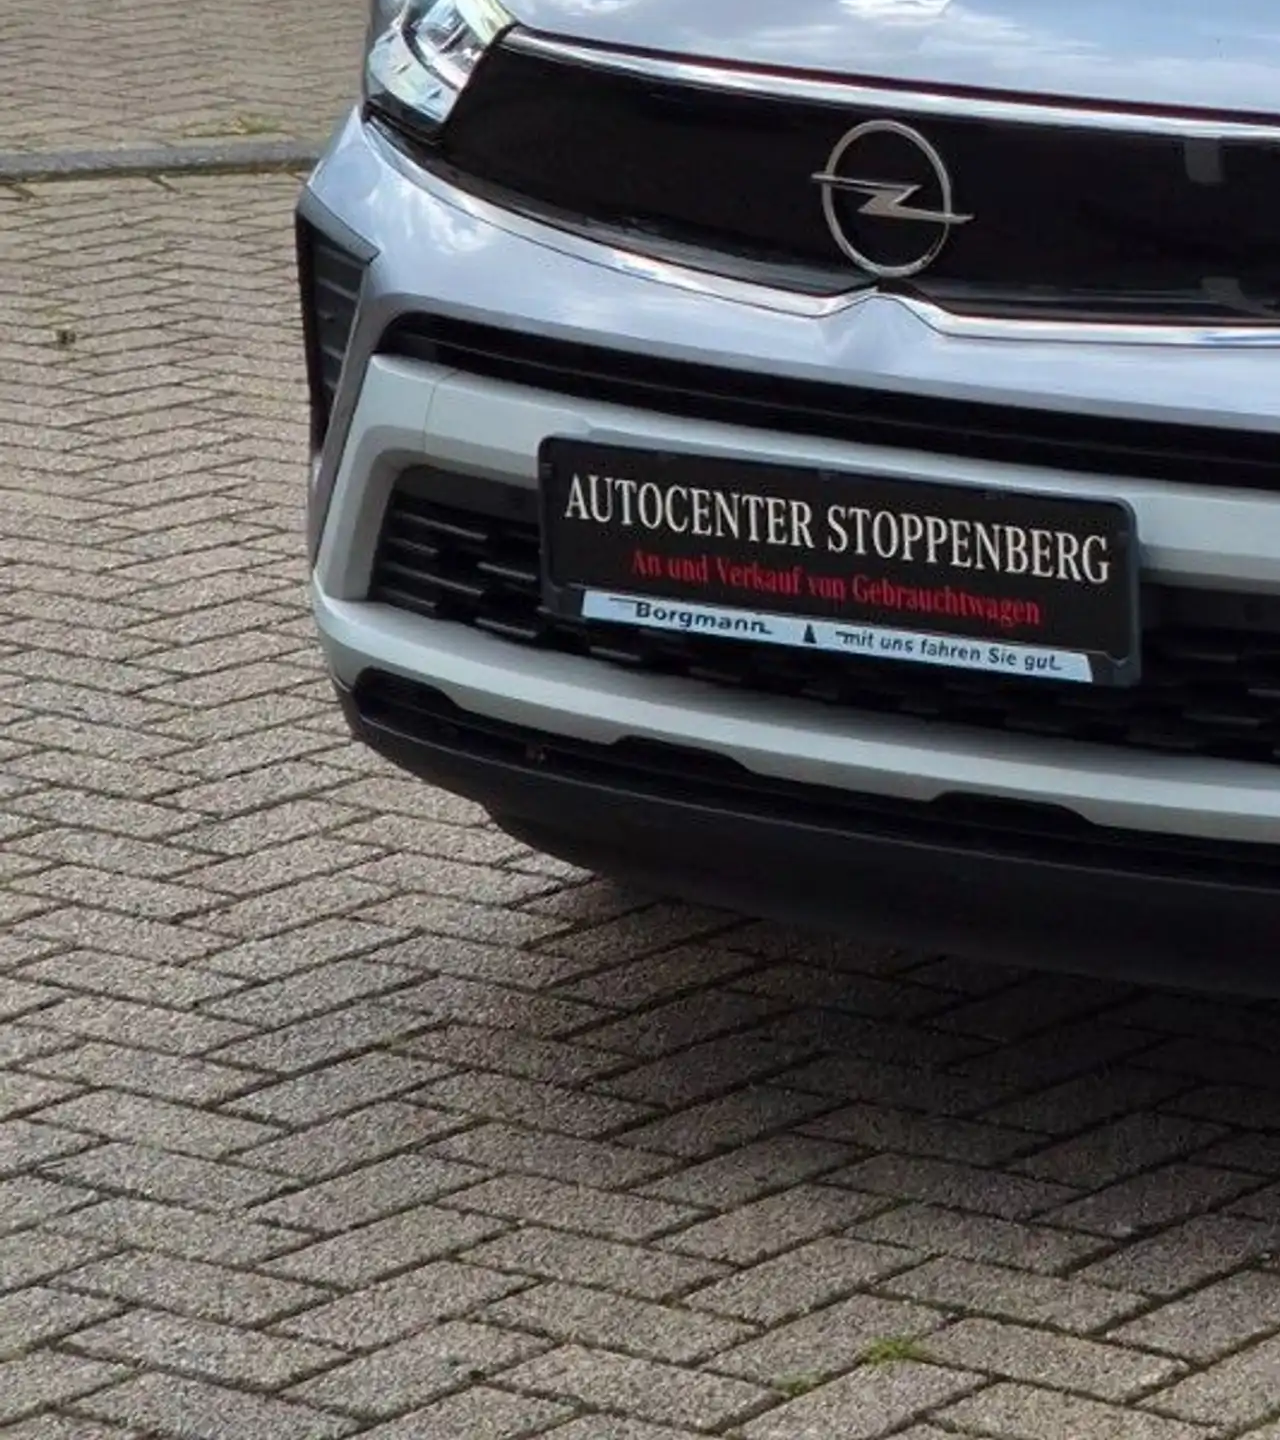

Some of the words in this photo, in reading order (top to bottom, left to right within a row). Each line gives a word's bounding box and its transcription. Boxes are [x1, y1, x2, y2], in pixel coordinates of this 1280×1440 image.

[564, 472, 815, 550] AUTOCENTER
[826, 504, 1111, 584] STOPPENBERG
[631, 549, 663, 577] An
[667, 551, 709, 584] und
[716, 557, 802, 596] Verkauf
[805, 573, 846, 602] von
[852, 578, 1042, 628] Gebrauchtwagen
[837, 630, 874, 649] mit
[880, 636, 914, 653] uns
[920, 638, 982, 662] fahren
[987, 647, 1017, 667] Sie
